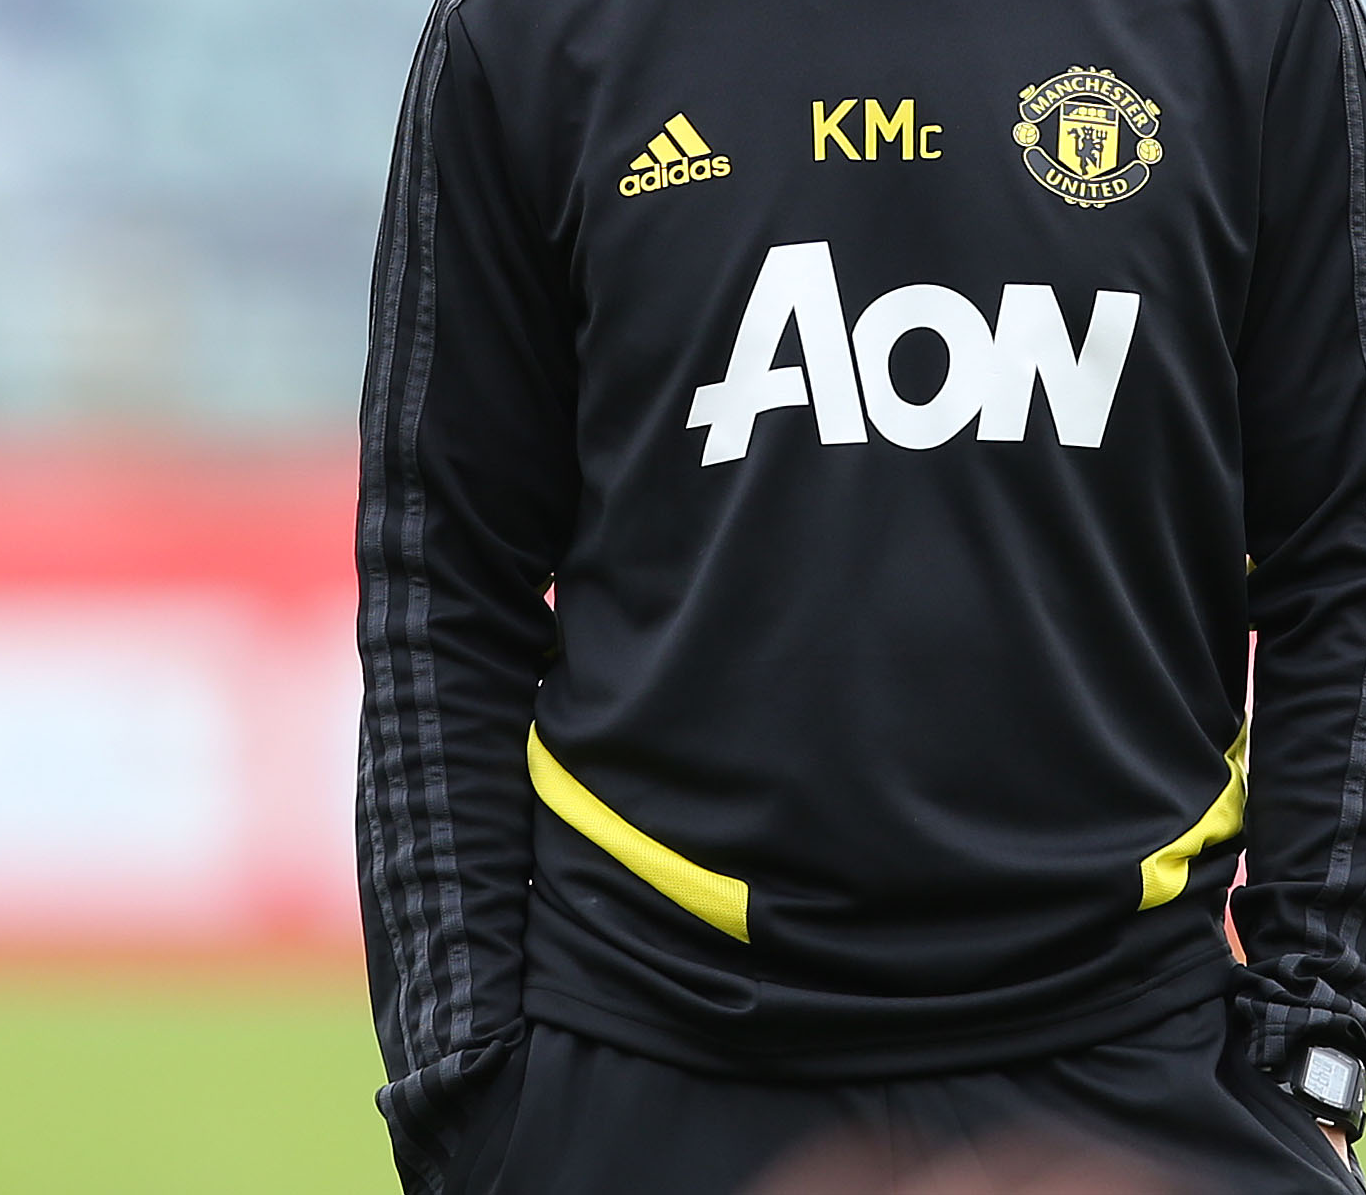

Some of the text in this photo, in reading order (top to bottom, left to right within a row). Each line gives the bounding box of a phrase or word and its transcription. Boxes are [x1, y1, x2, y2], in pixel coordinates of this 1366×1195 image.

[1030, 76, 1149, 129] MANCHESTER
[619, 151, 732, 198] adidas
[1045, 168, 1129, 199] UNITED
[686, 240, 1141, 467] AON
